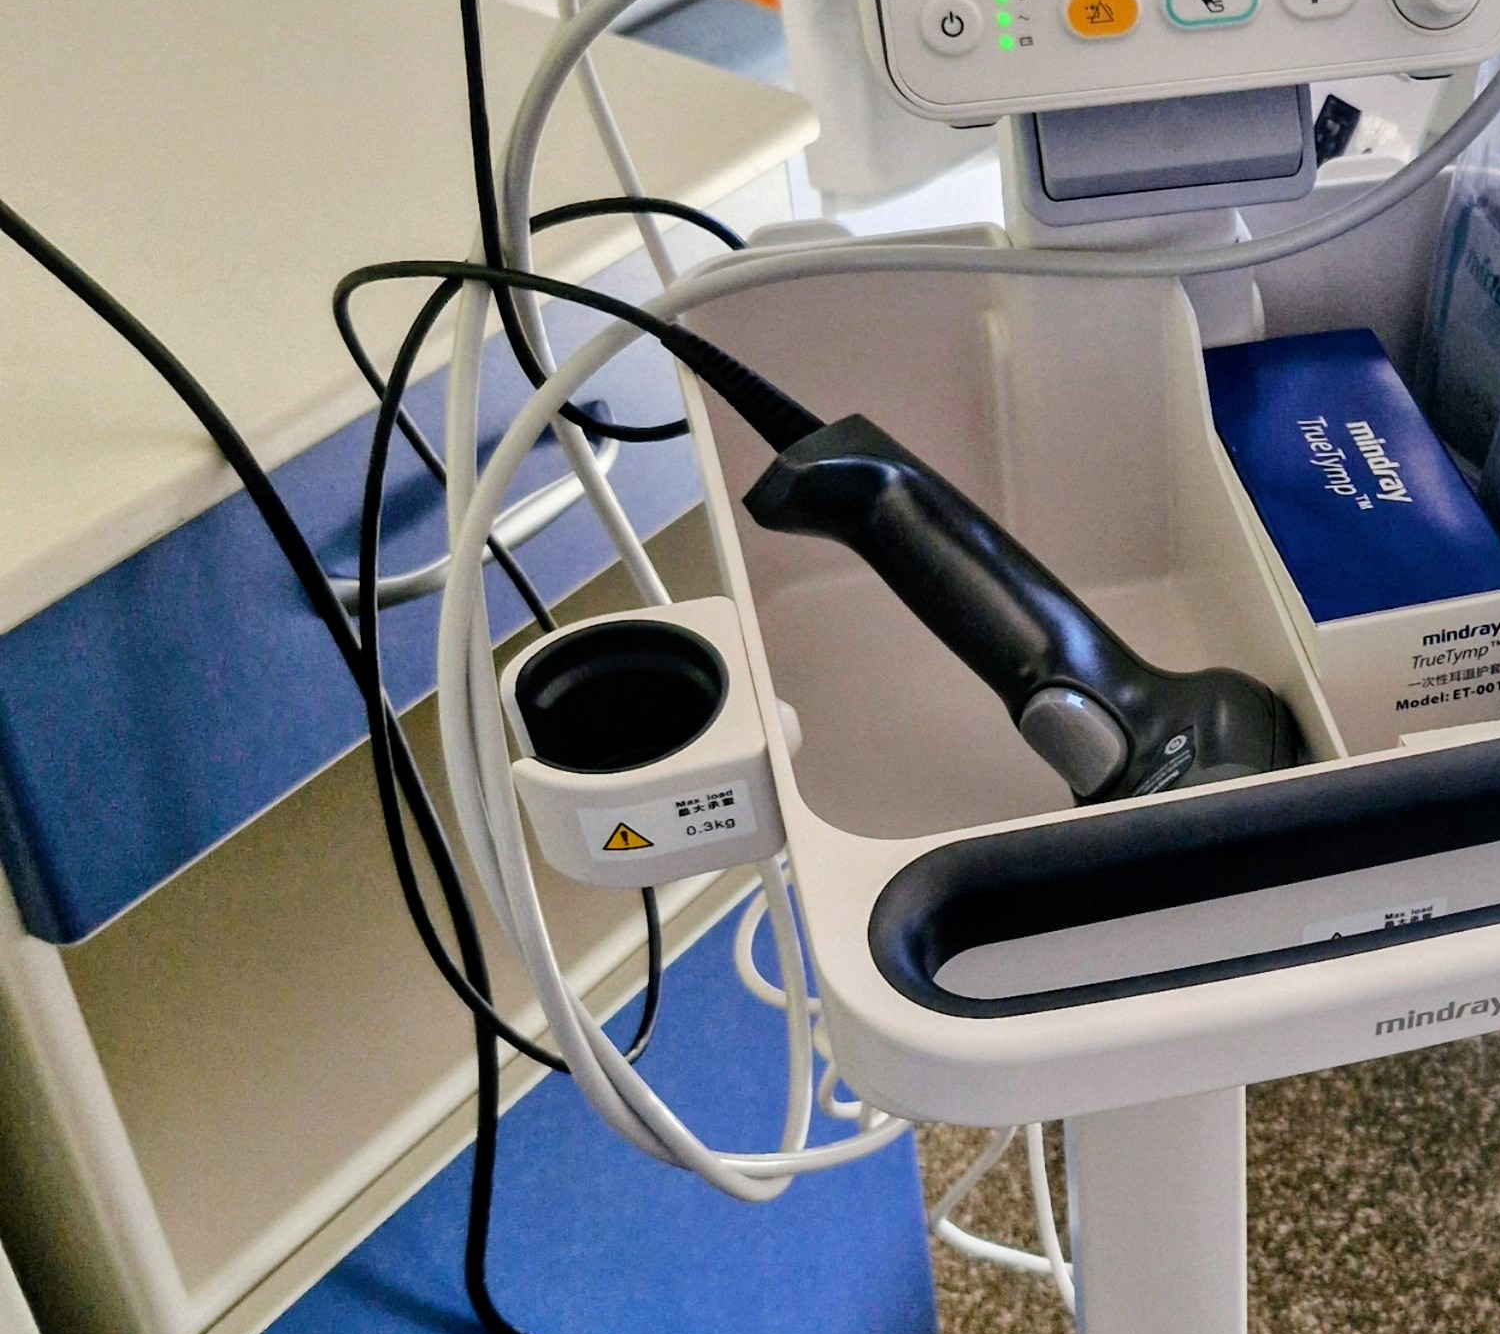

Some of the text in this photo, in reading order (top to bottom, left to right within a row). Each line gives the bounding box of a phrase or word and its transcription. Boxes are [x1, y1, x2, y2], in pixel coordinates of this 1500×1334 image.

[1345, 421, 1414, 504] mindray
[1395, 692, 1450, 711] Model:
[707, 789, 733, 800] load
[686, 818, 736, 836] 0.3kg
[1411, 905, 1434, 915] load
